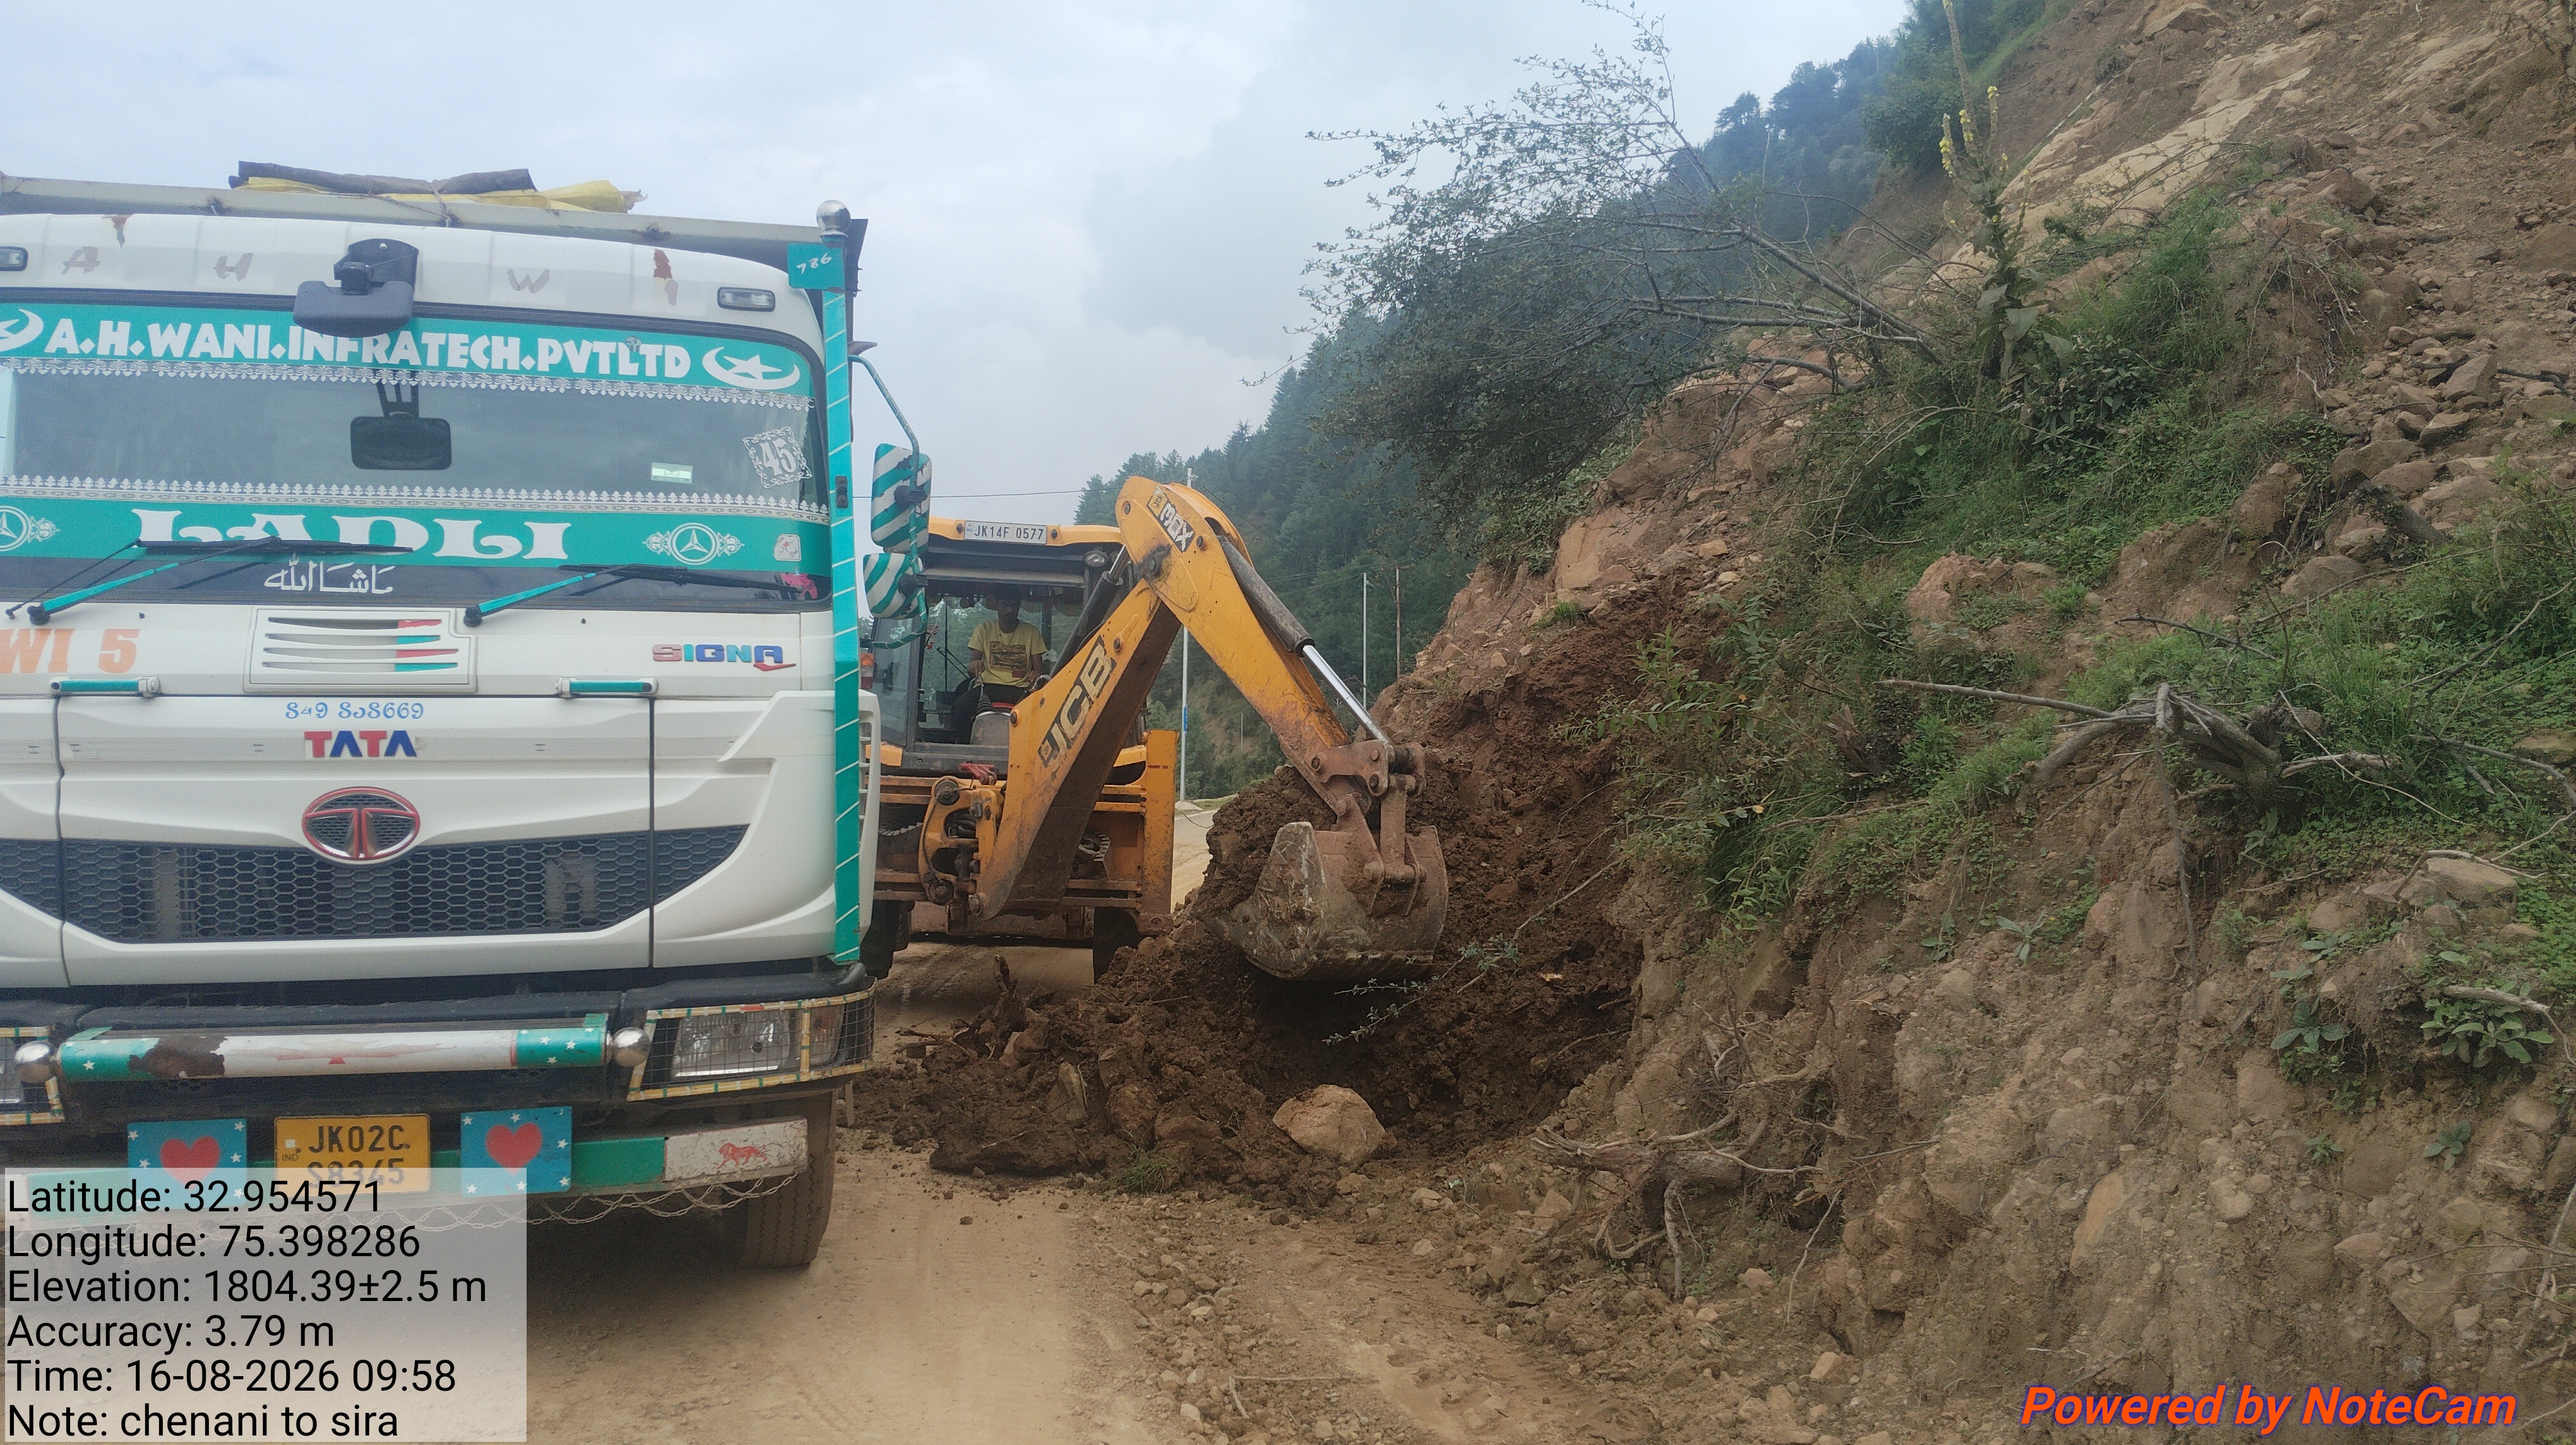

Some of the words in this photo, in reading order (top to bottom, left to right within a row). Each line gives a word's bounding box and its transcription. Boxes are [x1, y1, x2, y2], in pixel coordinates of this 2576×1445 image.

[796, 252, 833, 275] 786
[759, 438, 797, 477] 45
[131, 508, 571, 560] LADLI
[974, 525, 1010, 539] JK14F
[1015, 527, 1044, 540] 0577
[97, 628, 141, 674] 5
[652, 643, 785, 664] SIGNA
[1047, 642, 1113, 765] JCB
[304, 730, 417, 758] TATA
[308, 1124, 405, 1153] JK02C
[282, 1154, 299, 1162] IND
